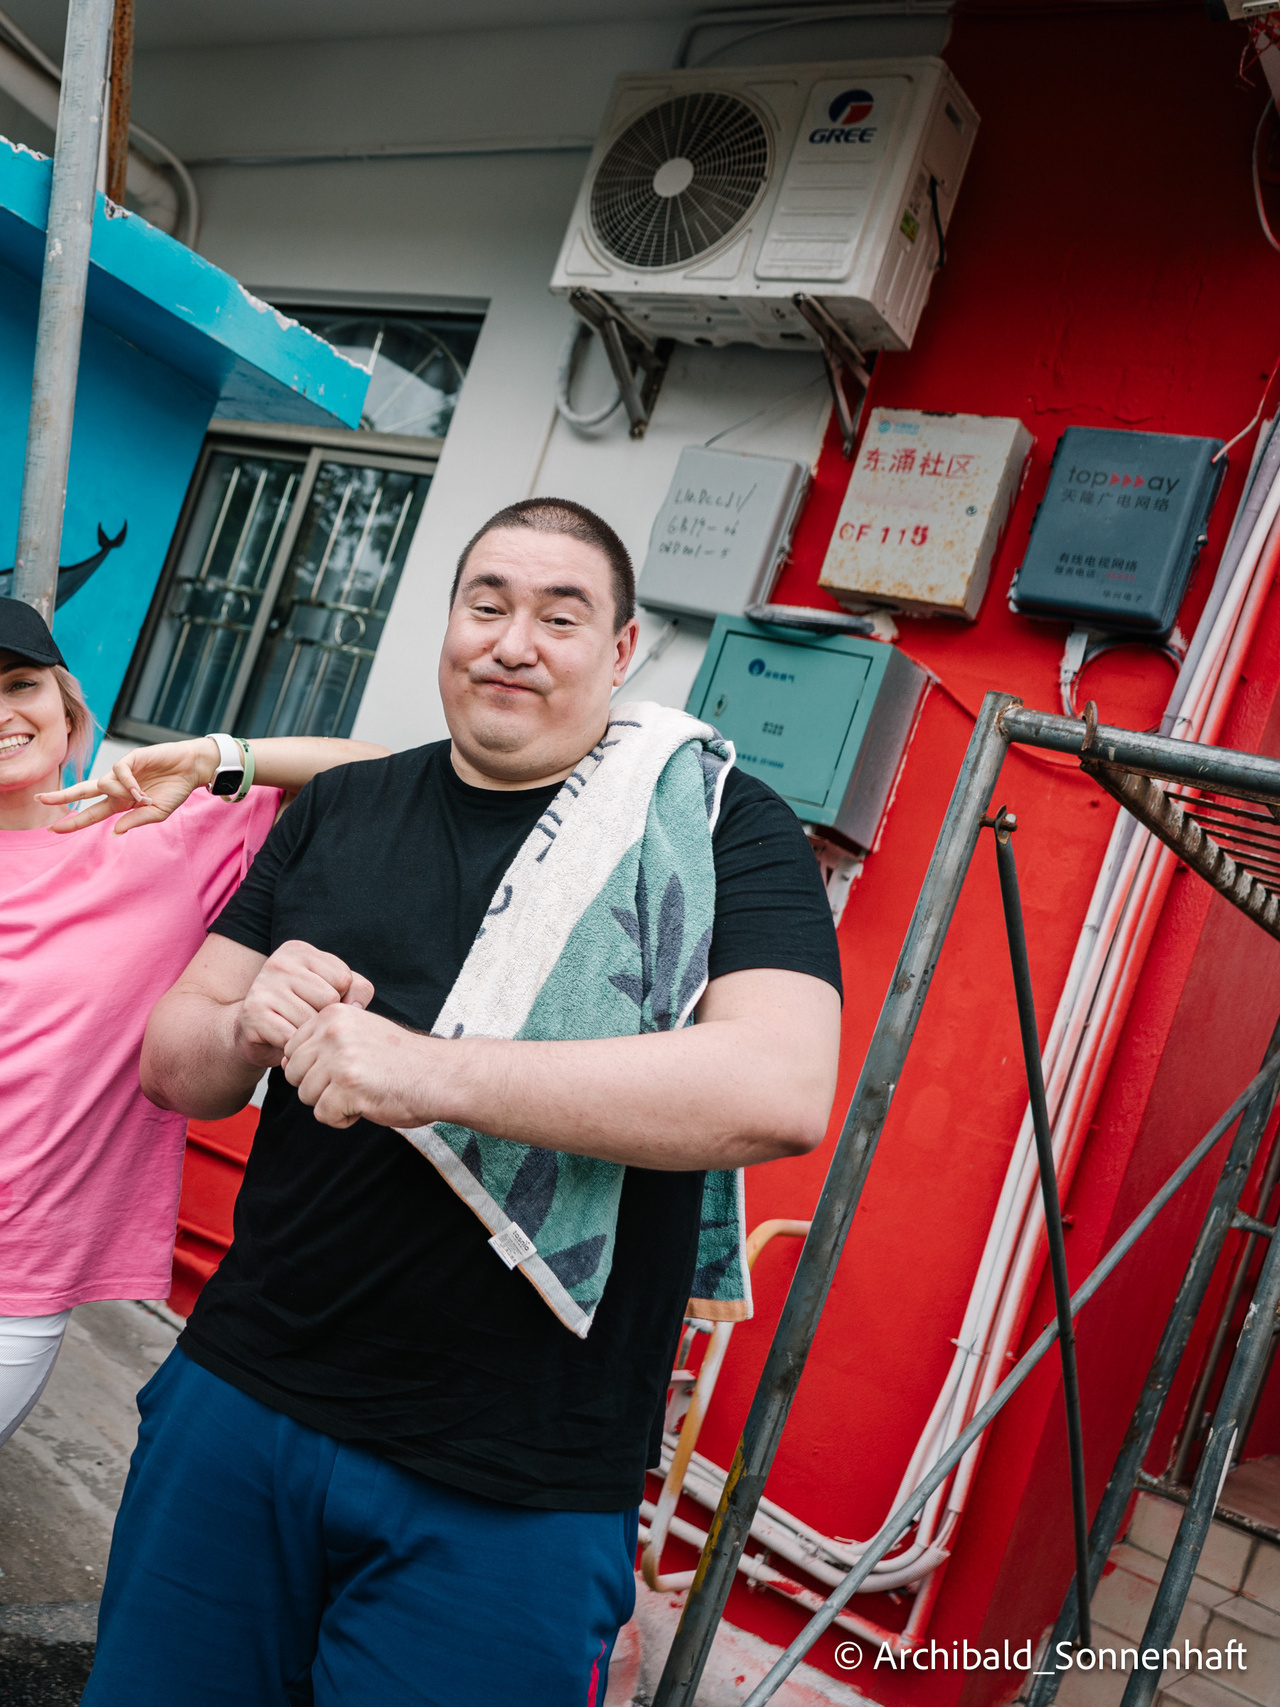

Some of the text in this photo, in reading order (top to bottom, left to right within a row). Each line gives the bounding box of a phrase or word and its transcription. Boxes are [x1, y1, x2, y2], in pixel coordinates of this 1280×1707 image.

[809, 127, 878, 145] GREE
[862, 447, 977, 479] 东涌社区
[1059, 552, 1138, 573] 有线电视网络
